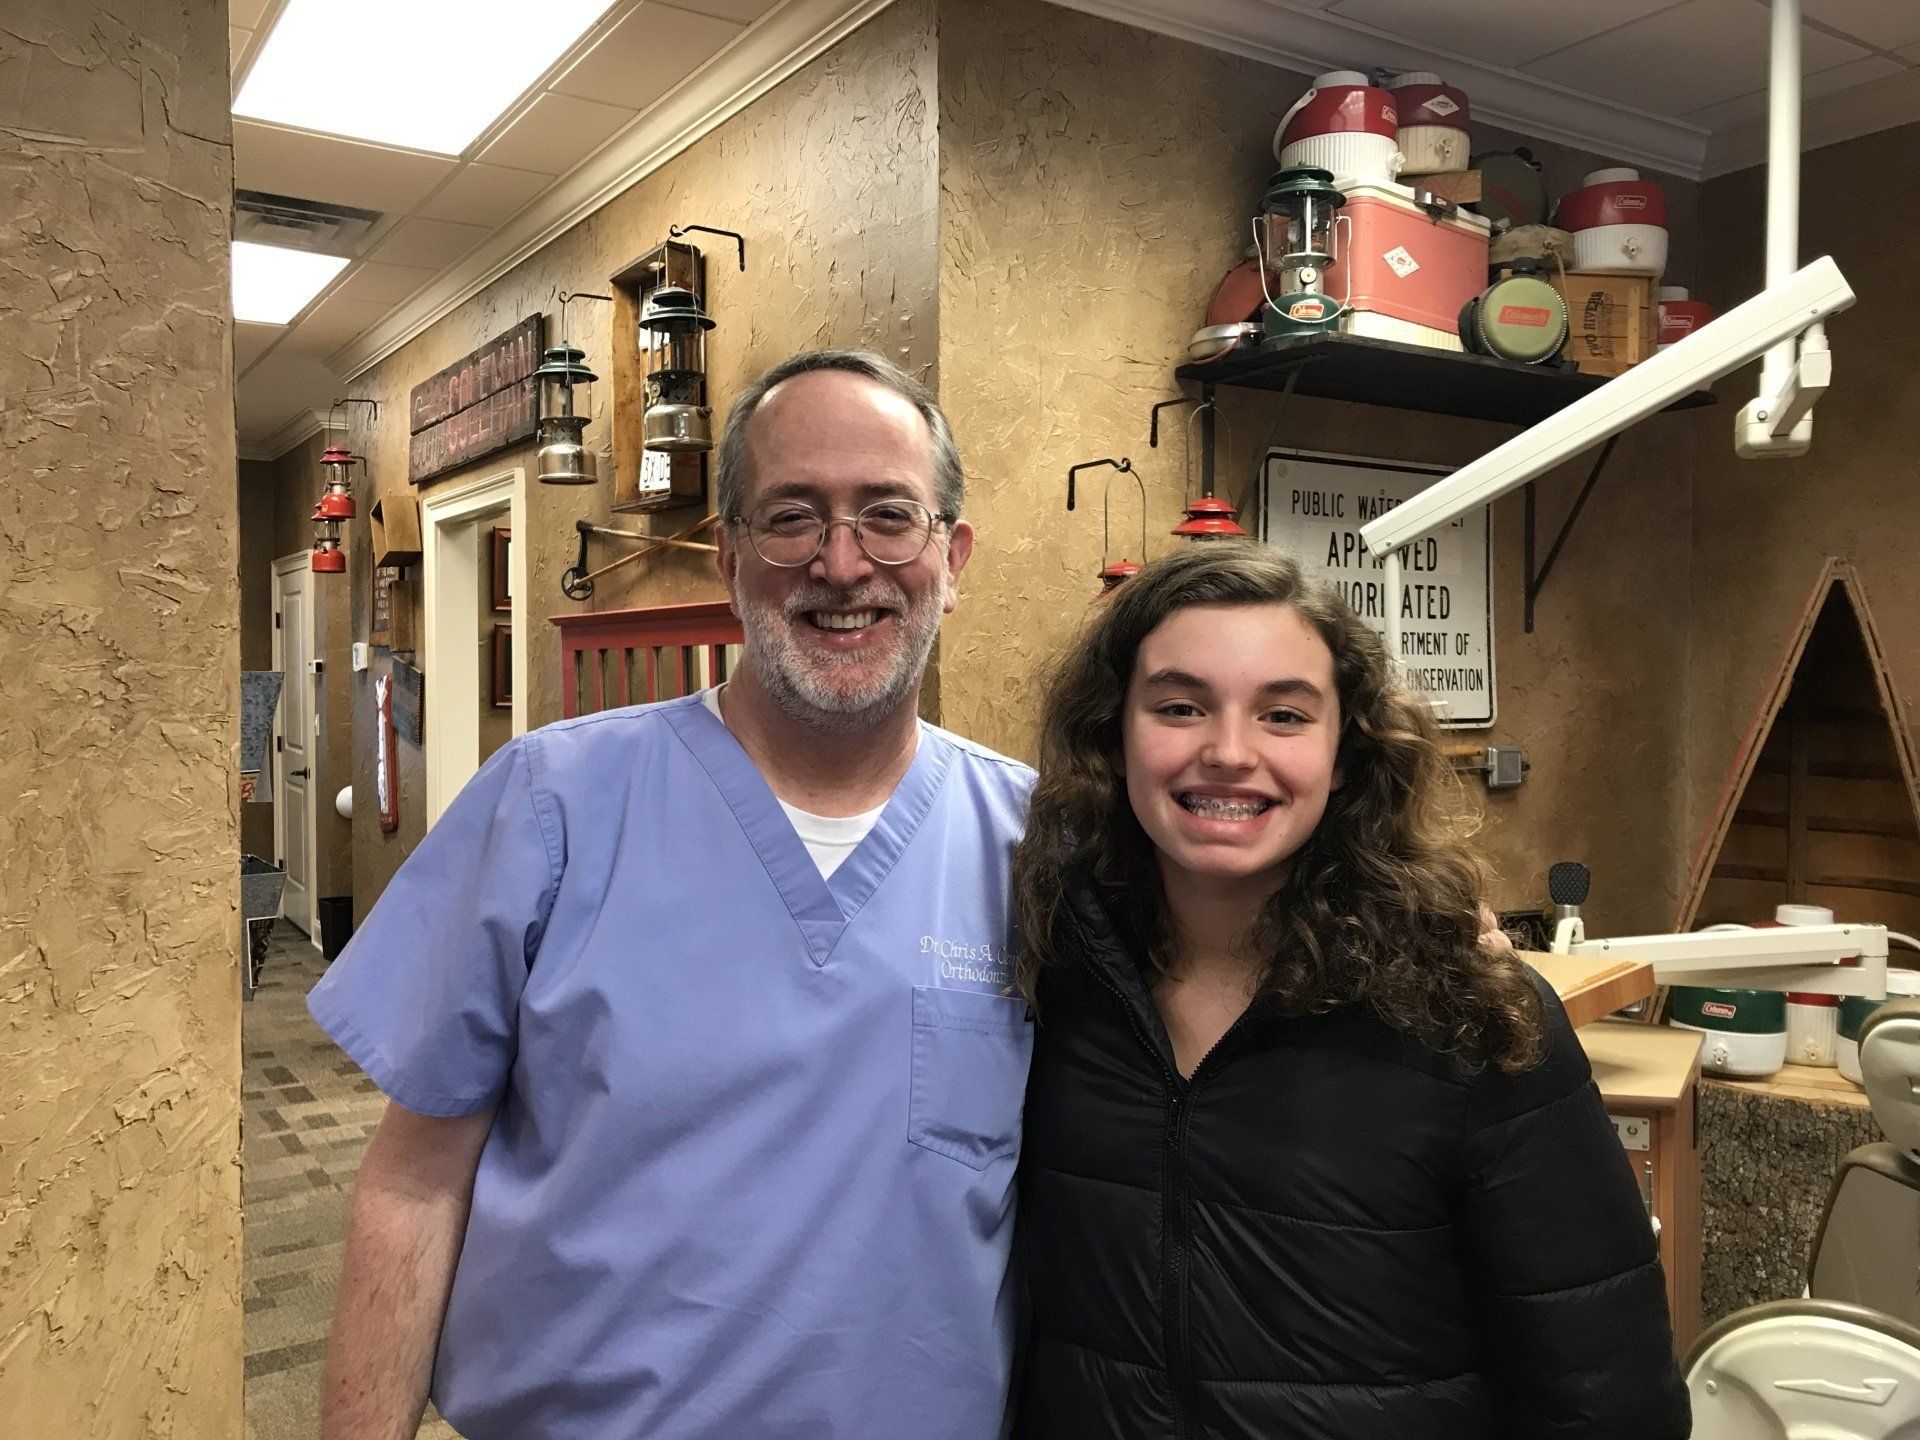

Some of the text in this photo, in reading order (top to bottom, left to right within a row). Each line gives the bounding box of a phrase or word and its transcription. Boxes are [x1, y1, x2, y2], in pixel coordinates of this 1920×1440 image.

[1292, 489, 1403, 521] PUBLIC WATE
[1326, 531, 1438, 571] APPVED
[1401, 632, 1470, 656] RTMENT OF
[1406, 668, 1483, 691] ONSERVATION
[920, 935, 940, 954] Dr.
[941, 940, 976, 960] Chris
[979, 943, 996, 962] A.
